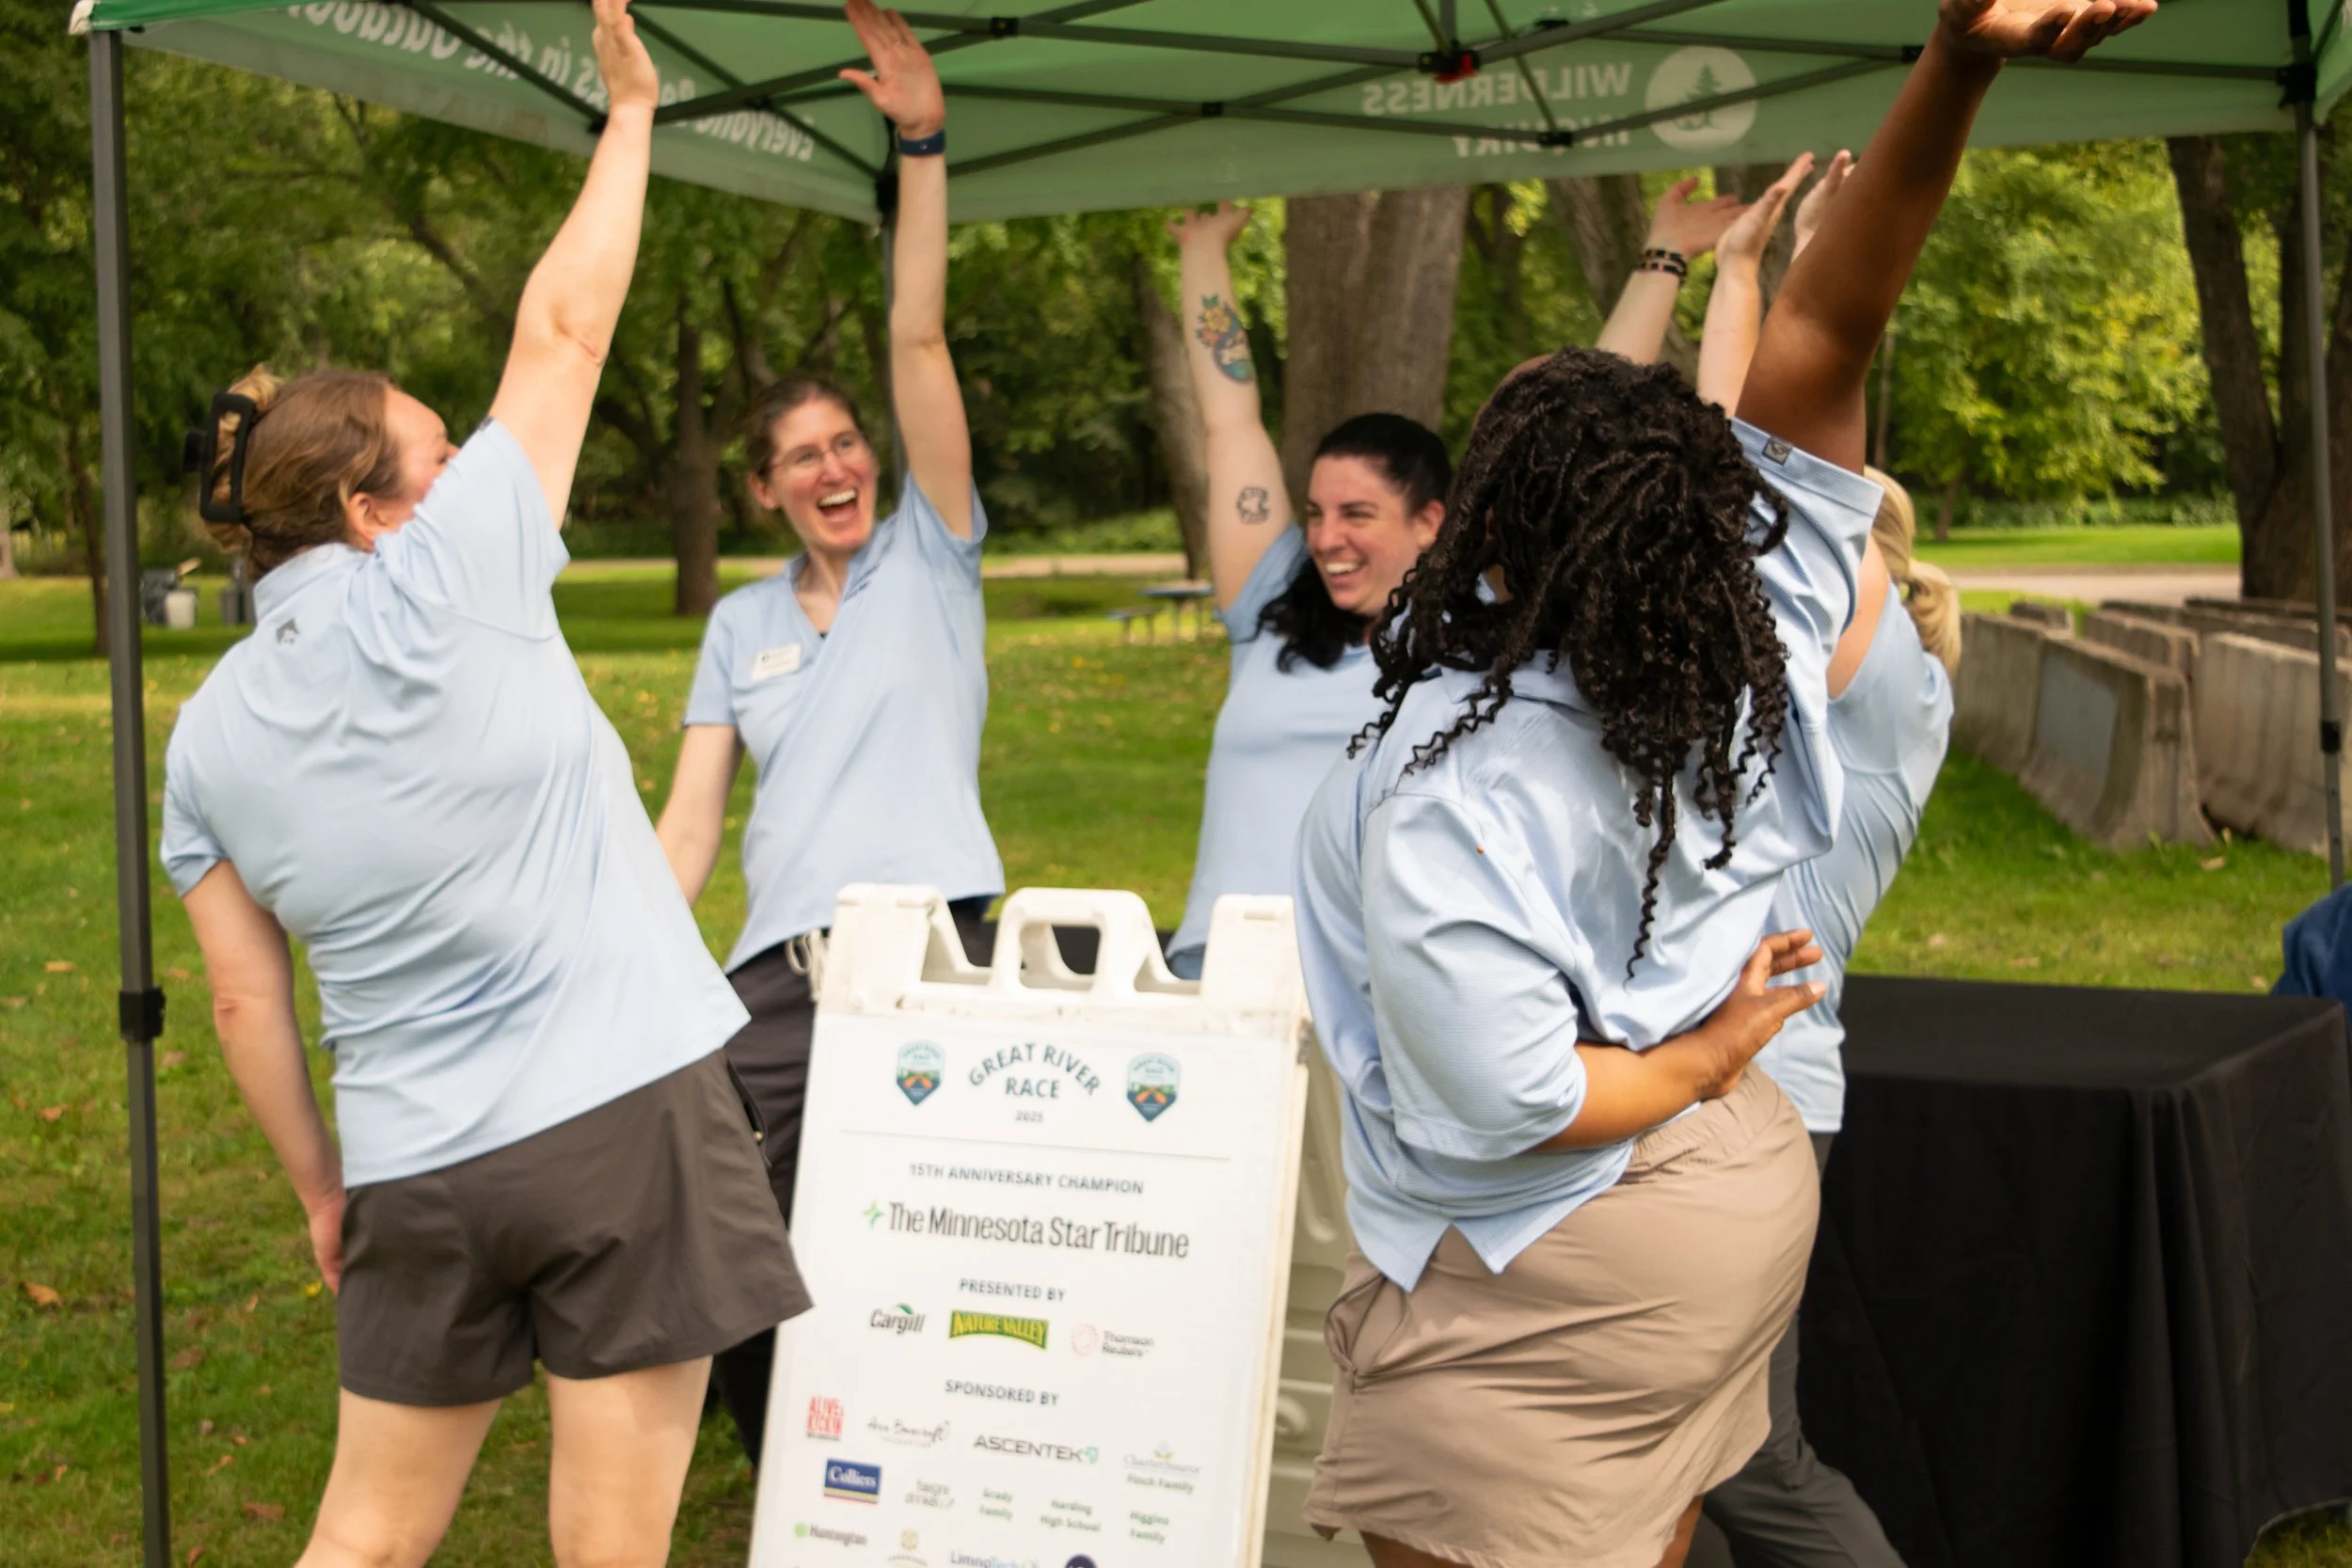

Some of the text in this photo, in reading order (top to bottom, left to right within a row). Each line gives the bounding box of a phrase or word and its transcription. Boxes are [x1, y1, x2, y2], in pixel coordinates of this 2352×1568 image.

[968, 1042, 1100, 1096] GREAT RIVER
[1005, 1077, 1060, 1099] RACE
[1015, 1111, 1043, 1123] 2025
[910, 1164, 1144, 1195] 15TH ANNIVERSARY CHAMPION
[889, 1201, 1190, 1259] The Minnesota Star Tribune
[960, 1277, 1066, 1302] PRESENTED BY
[870, 1308, 926, 1335] Cargill
[952, 1311, 1045, 1345] NATURE VALLEY
[946, 1379, 1059, 1406] SPONSORED BY
[974, 1434, 1083, 1462] ASCENTEK
[828, 1465, 878, 1487] Colliers
[1159, 1478, 1194, 1495] Family
[979, 1505, 1013, 1520] Family
[1051, 1499, 1092, 1516] Harding
[1041, 1514, 1101, 1532] High School
[1130, 1528, 1166, 1544] Family
